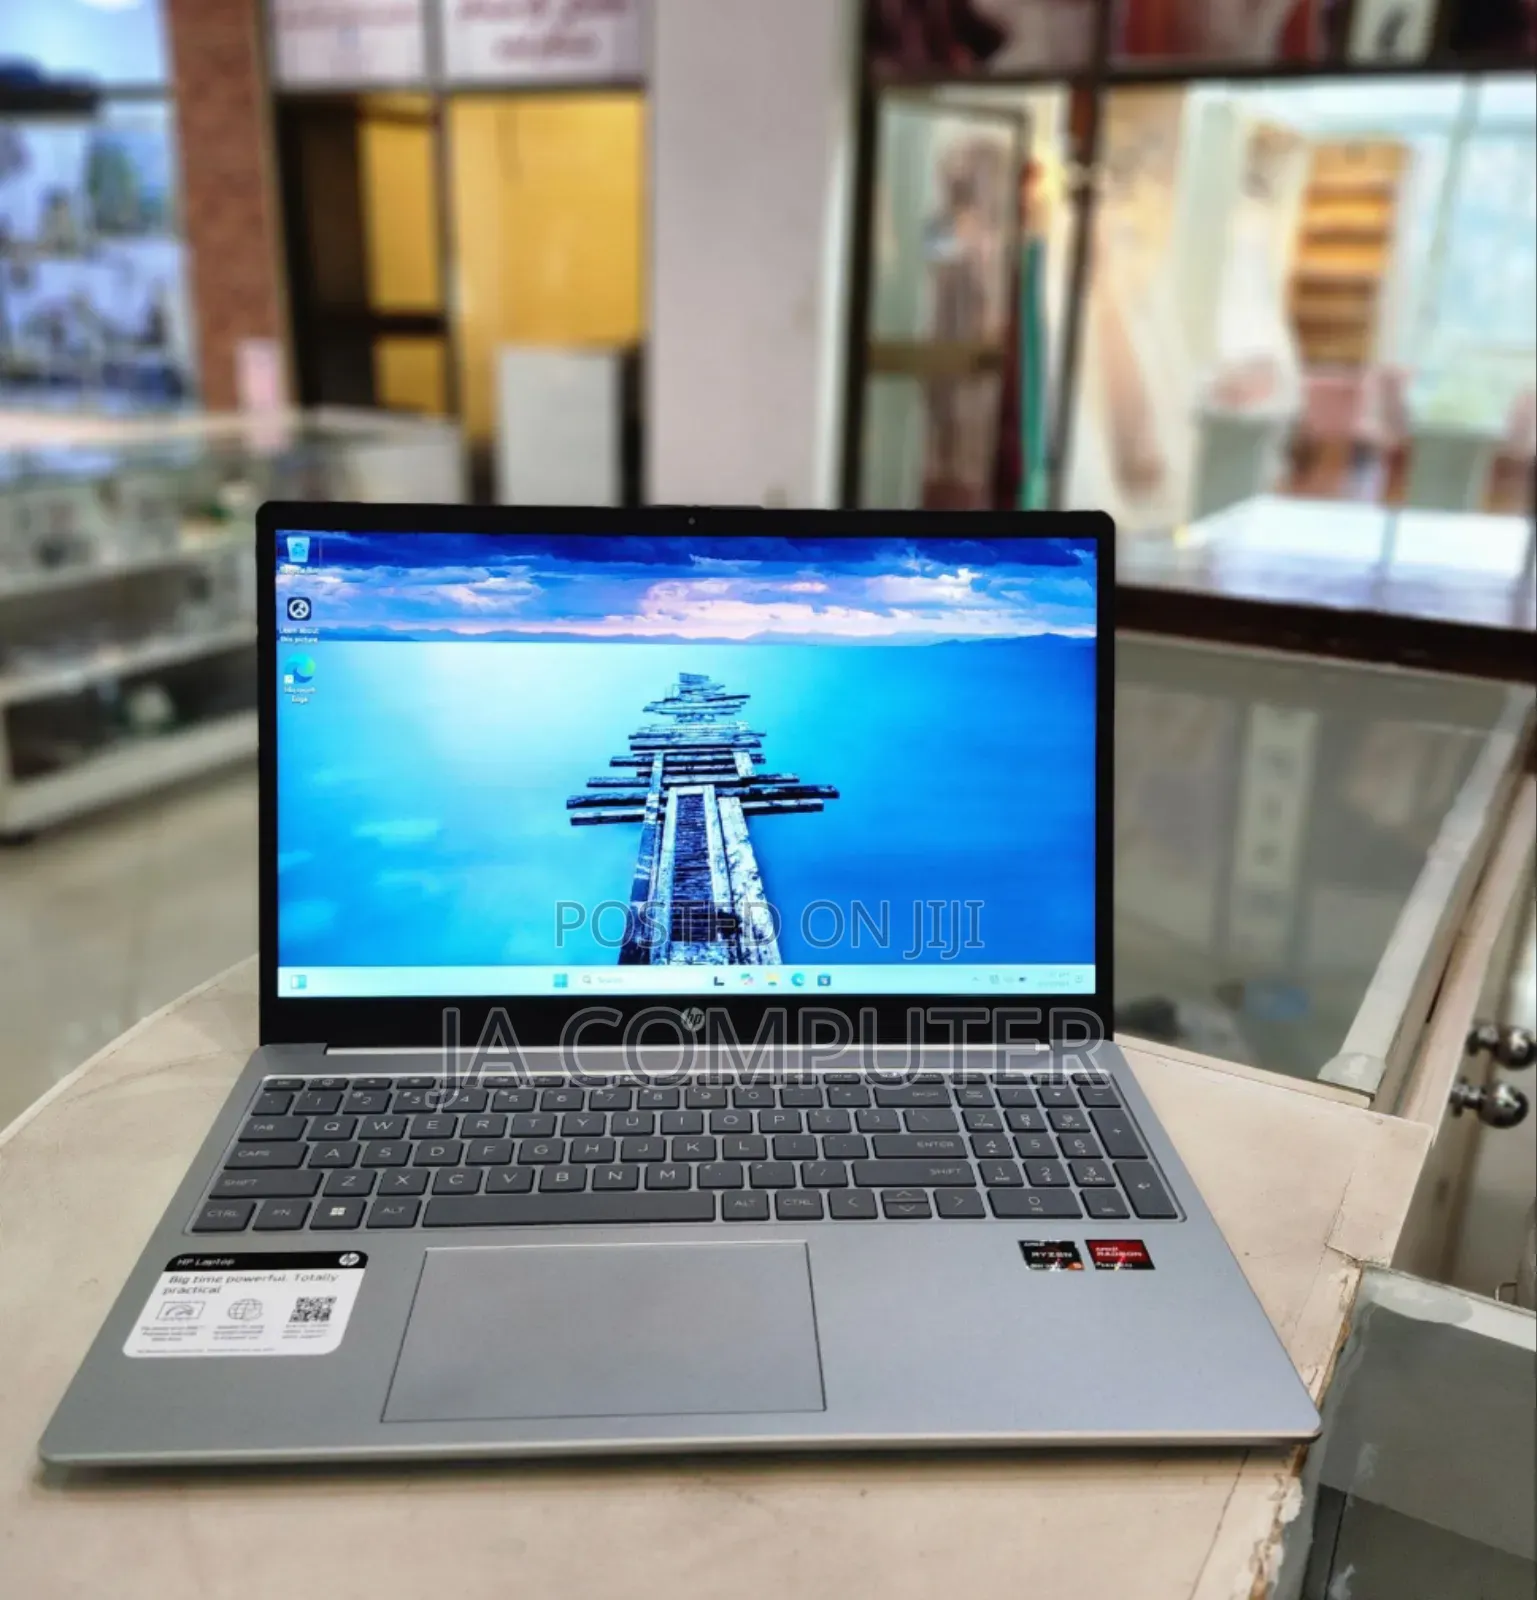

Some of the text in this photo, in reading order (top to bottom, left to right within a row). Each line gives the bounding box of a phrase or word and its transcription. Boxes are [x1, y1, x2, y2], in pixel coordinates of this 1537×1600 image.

[324, 1121, 340, 1131] Q
[372, 1121, 393, 1130] W
[426, 1120, 439, 1129] E
[476, 1119, 490, 1129] R
[528, 1118, 541, 1128] T
[577, 1118, 590, 1127] Y
[626, 1117, 639, 1126] U
[723, 1115, 739, 1125] O
[774, 1115, 785, 1124] P
[324, 1148, 340, 1158] A
[378, 1147, 392, 1158] S
[430, 1146, 445, 1156] D
[483, 1145, 496, 1155] F
[534, 1144, 548, 1155] G
[585, 1143, 599, 1153] H
[637, 1143, 649, 1152] J
[686, 1142, 699, 1152] K
[738, 1141, 750, 1150] L
[341, 1175, 357, 1186] Z
[395, 1175, 410, 1185] X
[449, 1174, 464, 1185] C
[503, 1172, 517, 1183] V
[555, 1171, 569, 1182] B
[608, 1171, 622, 1180] N
[660, 1170, 675, 1180] M
[176, 1258, 236, 1267] HP Laptop
[168, 1275, 191, 1285] Big
[192, 1274, 223, 1284] time
[293, 1272, 339, 1283] Totally
[162, 1285, 222, 1295] practical
